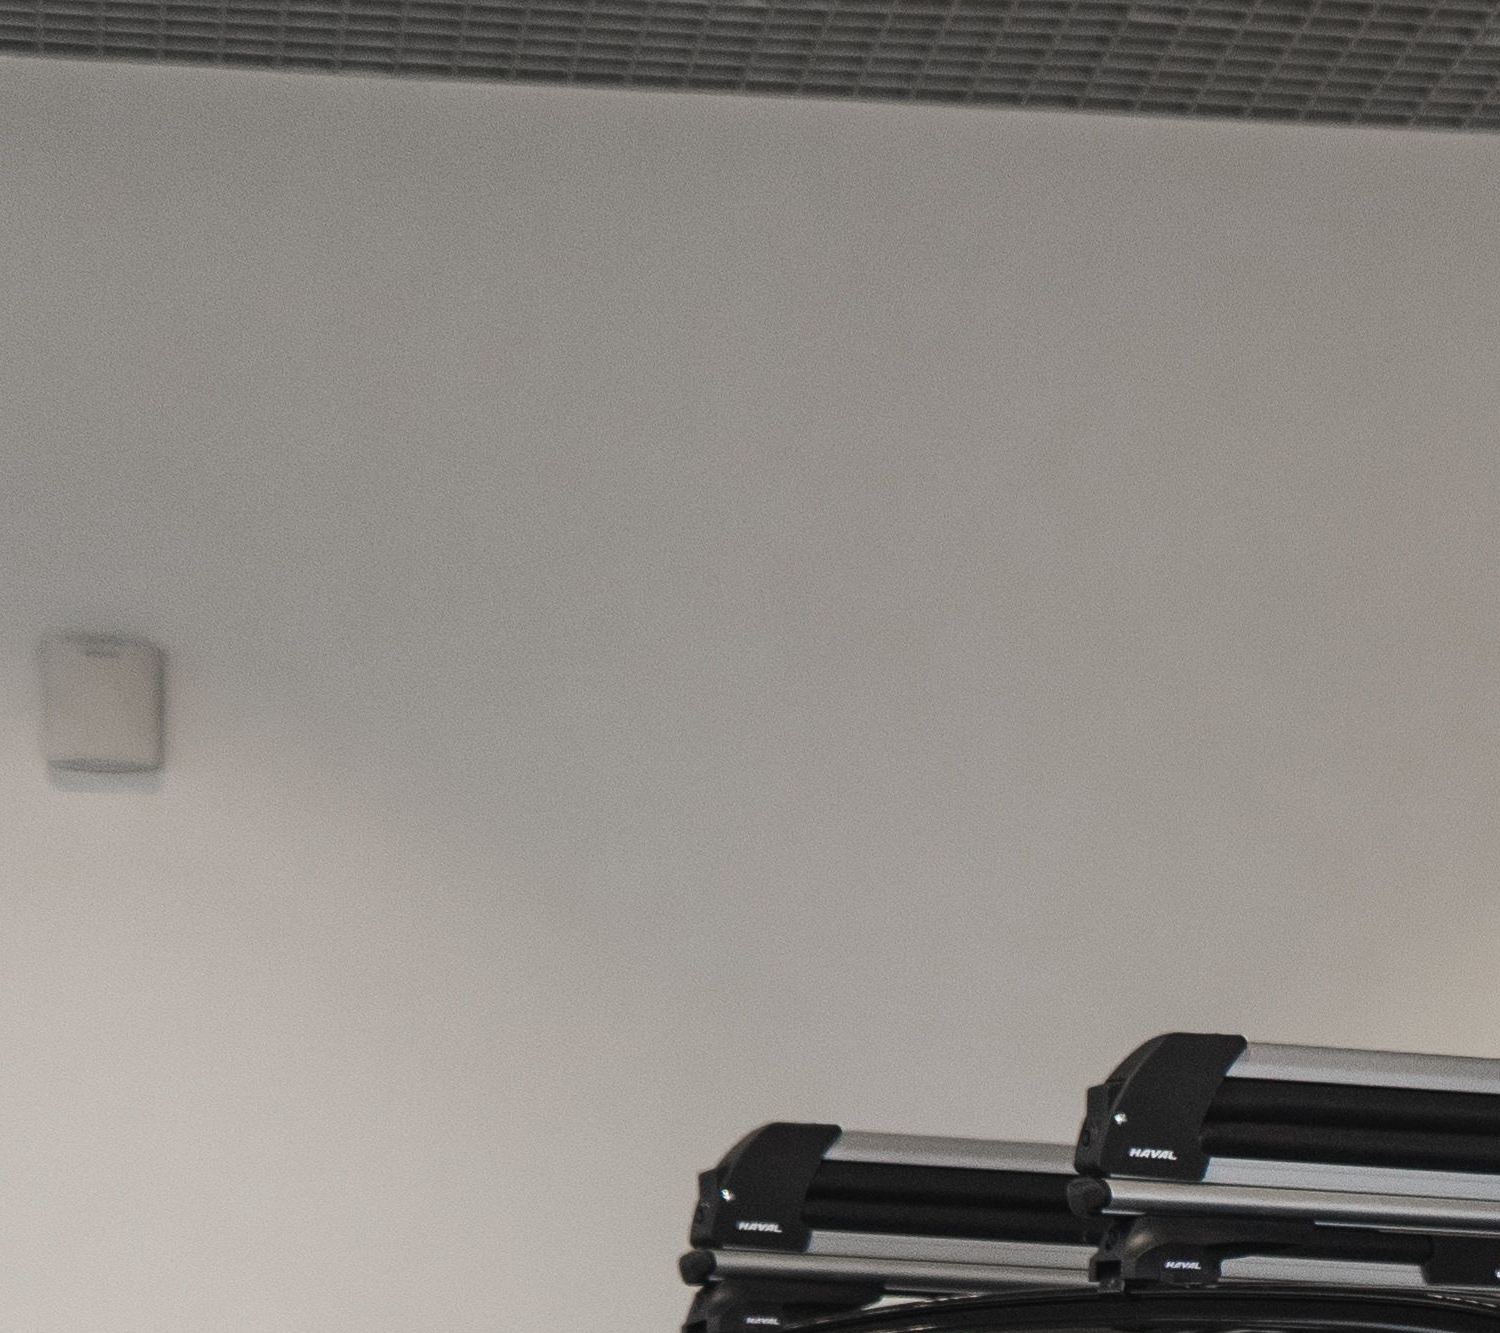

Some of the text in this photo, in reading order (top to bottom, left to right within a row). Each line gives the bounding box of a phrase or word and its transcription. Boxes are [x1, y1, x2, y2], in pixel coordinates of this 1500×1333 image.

[1128, 1148, 1178, 1160] HAVAL
[737, 1221, 783, 1233] HAVAL
[1164, 1261, 1202, 1270] HAVAL
